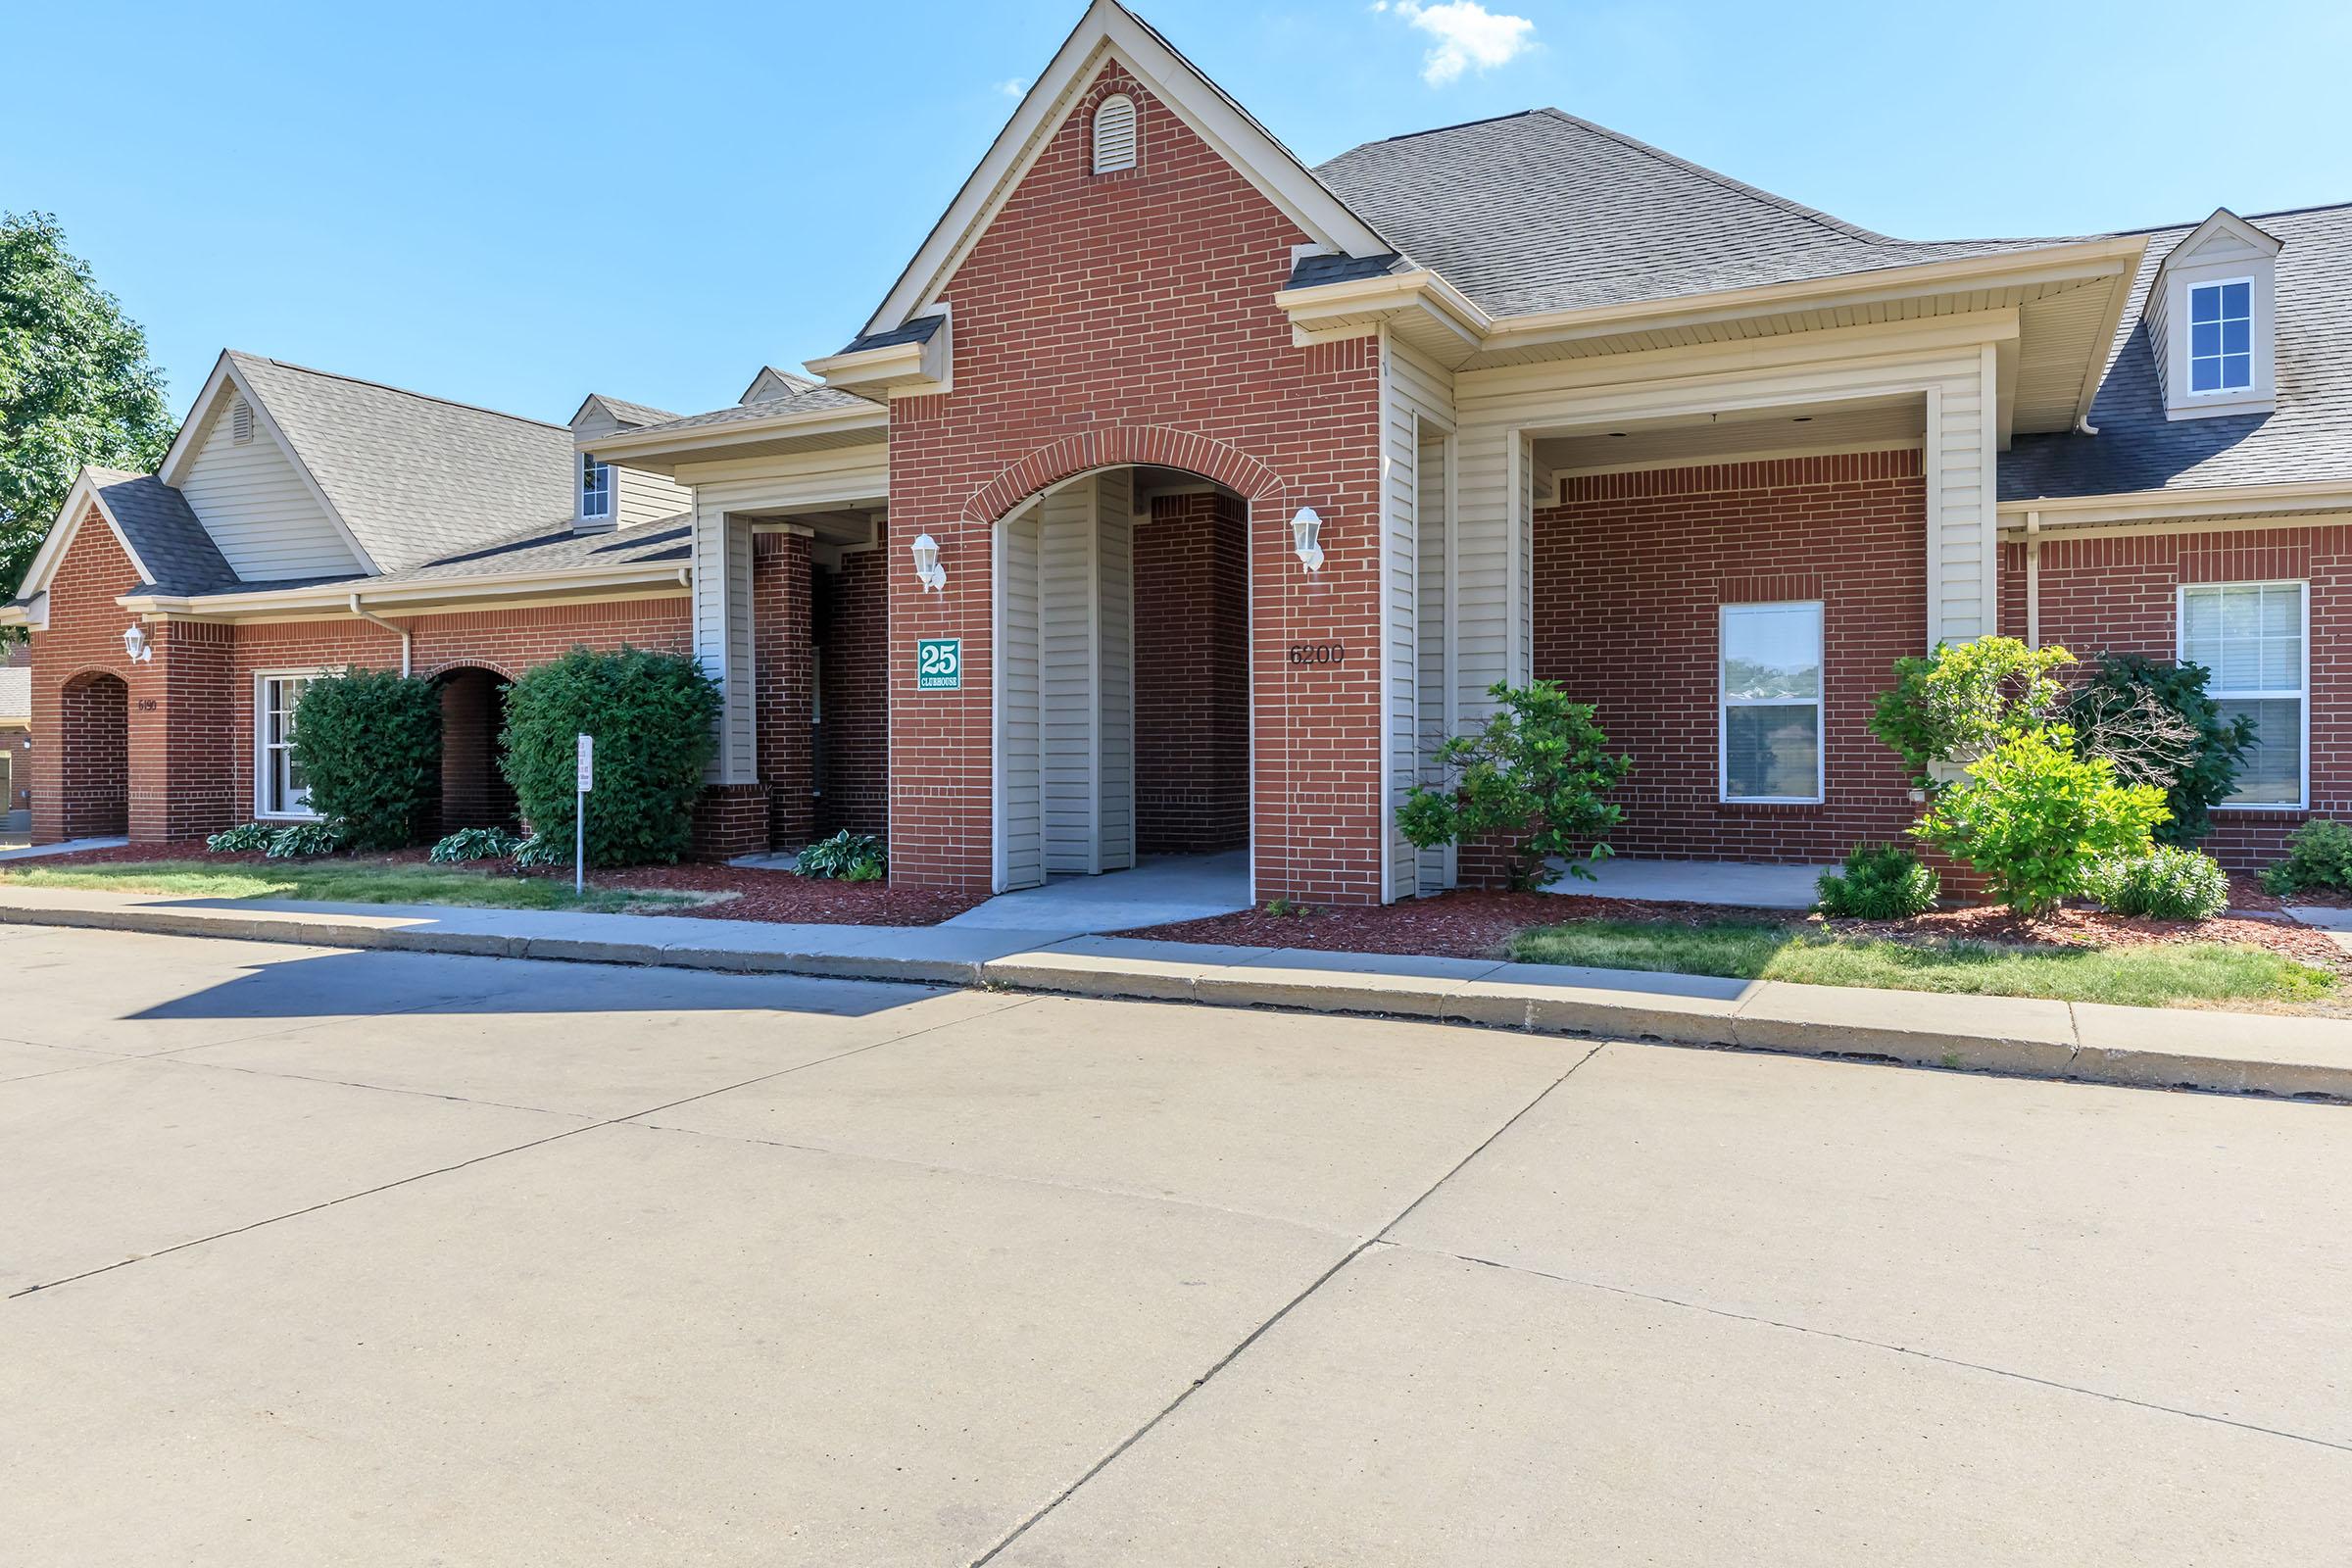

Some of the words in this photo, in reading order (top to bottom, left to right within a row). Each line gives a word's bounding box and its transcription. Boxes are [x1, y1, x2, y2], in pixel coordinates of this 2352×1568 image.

[921, 645, 956, 674] 25
[1291, 644, 1344, 663] 6200
[921, 677, 956, 686] CLUBHOUSE
[139, 700, 157, 710] 6190
